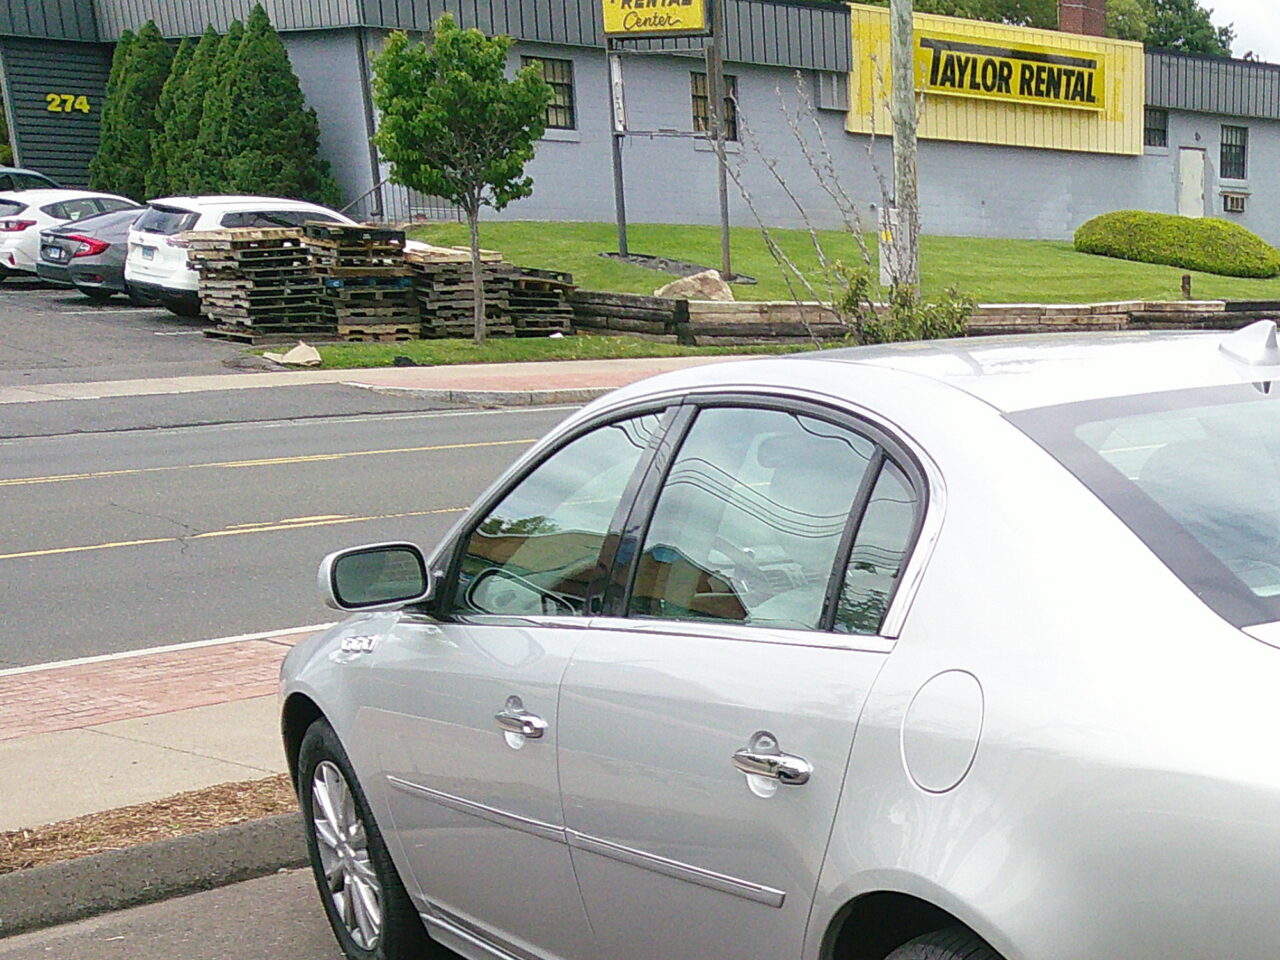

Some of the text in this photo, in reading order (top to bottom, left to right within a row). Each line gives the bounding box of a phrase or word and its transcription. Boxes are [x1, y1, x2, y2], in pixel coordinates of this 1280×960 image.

[623, 11, 681, 30] Center
[920, 37, 1096, 103] TAYLOR RENTAL
[46, 93, 90, 113] 274
